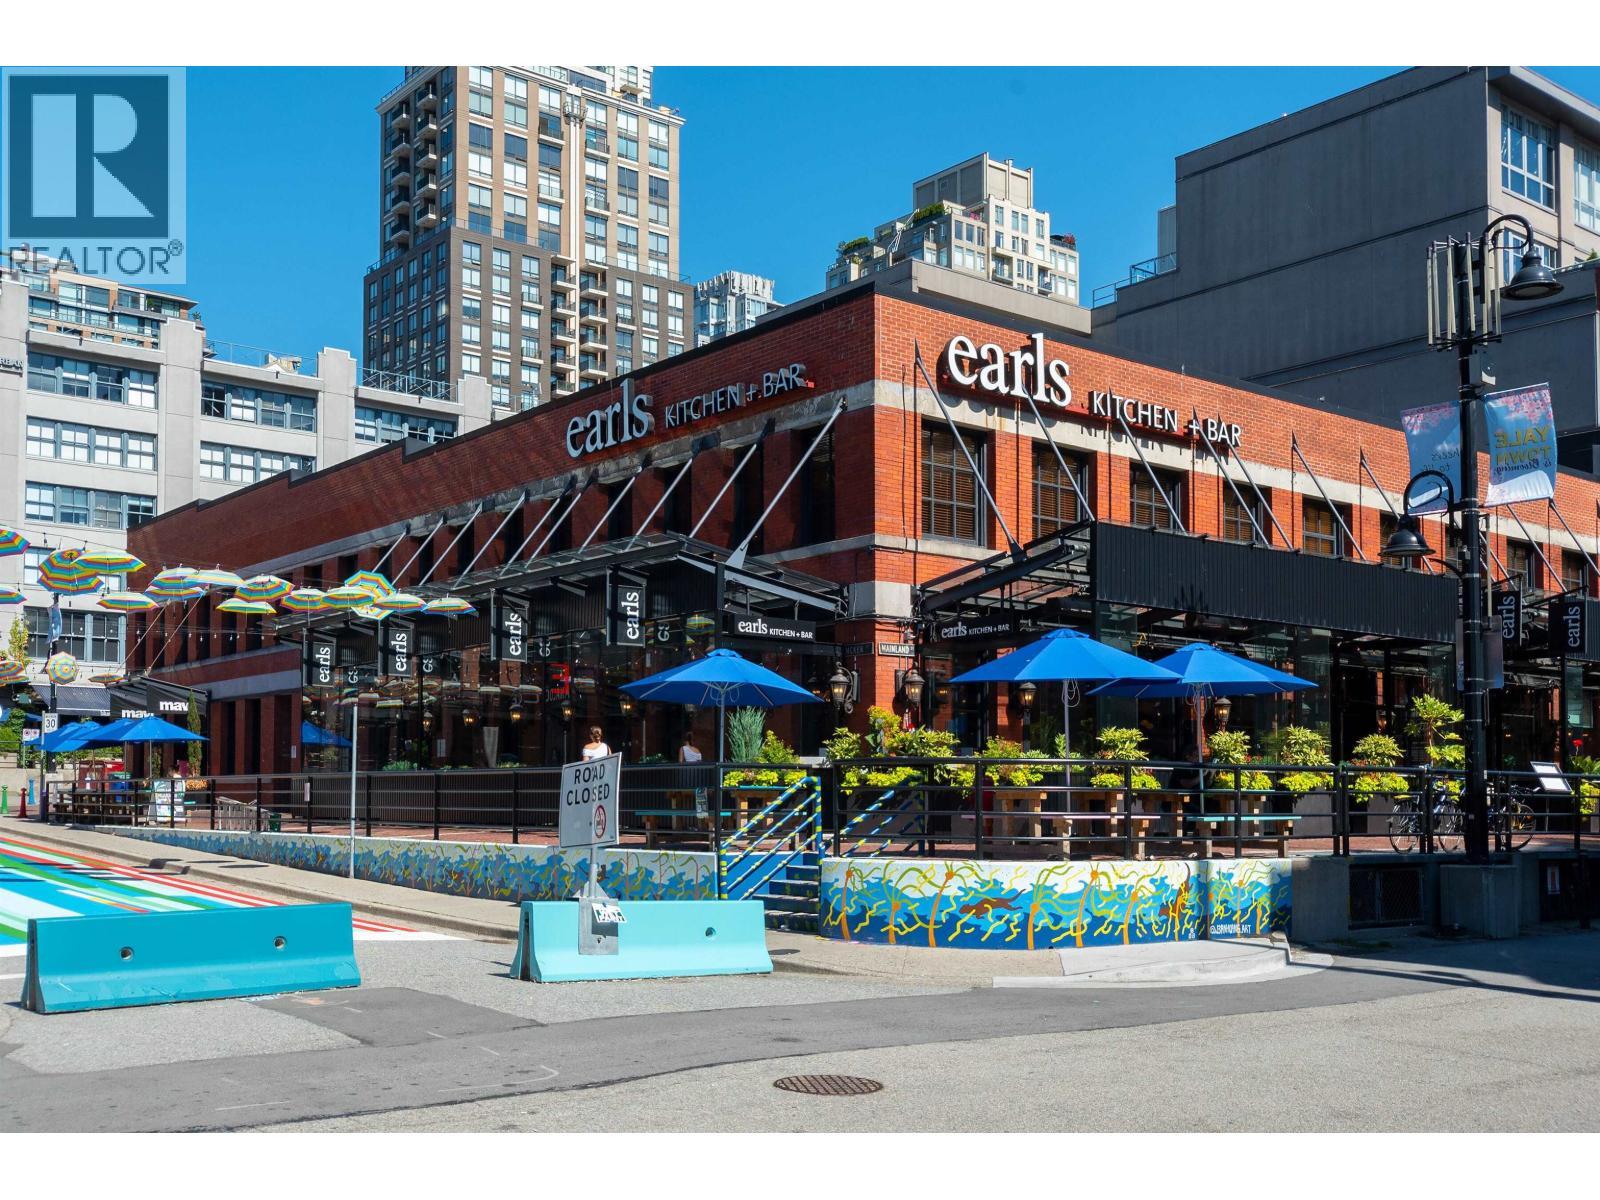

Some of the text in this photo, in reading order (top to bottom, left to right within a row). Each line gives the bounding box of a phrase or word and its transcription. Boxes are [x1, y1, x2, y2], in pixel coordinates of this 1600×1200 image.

[949, 333, 1072, 407] earls
[1093, 390, 1178, 432] KITCHEN
[1208, 418, 1242, 447] BAR
[566, 378, 652, 459] earls
[665, 384, 741, 429] KITCHEN
[763, 363, 802, 398] BAR
[621, 591, 640, 640] earls
[738, 618, 768, 634] earls
[769, 628, 796, 637] KITCHEN
[800, 631, 813, 639] BAR
[941, 621, 967, 638] earls
[968, 625, 993, 636] KITCHEN
[997, 623, 1010, 632] BAR
[1498, 595, 1516, 639] earls
[1563, 606, 1580, 648] earls
[505, 612, 522, 656] earls
[391, 633, 407, 671] earls
[881, 644, 909, 654] MAINLAND
[315, 647, 331, 683] earls
[121, 709, 154, 718] mav
[160, 701, 189, 711] mav
[45, 718, 56, 728] 30
[574, 763, 605, 785] ROAD
[566, 783, 610, 806] CLOSED
